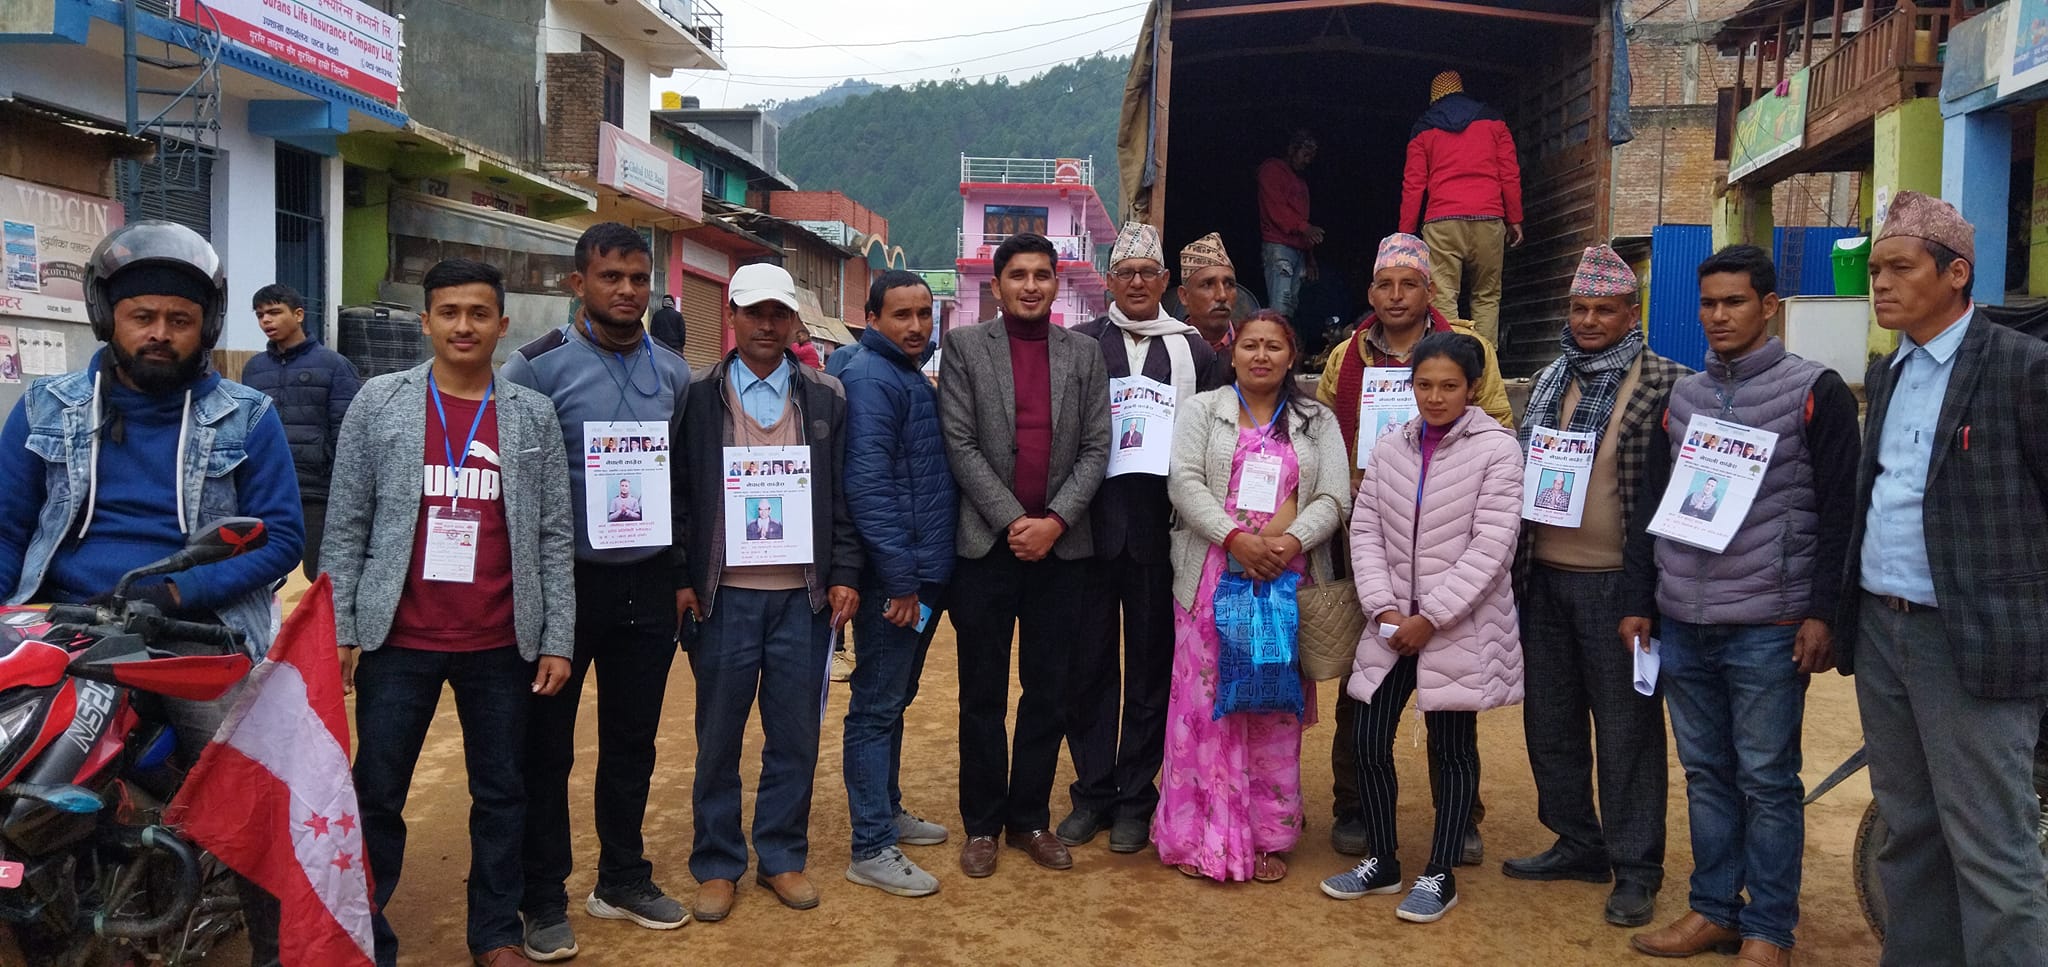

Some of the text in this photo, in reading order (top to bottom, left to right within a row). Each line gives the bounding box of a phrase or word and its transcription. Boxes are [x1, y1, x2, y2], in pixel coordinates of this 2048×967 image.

[293, 4, 308, 24] Life
[310, 12, 347, 42] Insurance
[348, 31, 380, 60] Company
[382, 45, 394, 63] Ltd.
[16, 184, 109, 237] VIRGIN
[423, 464, 501, 501] UMA
